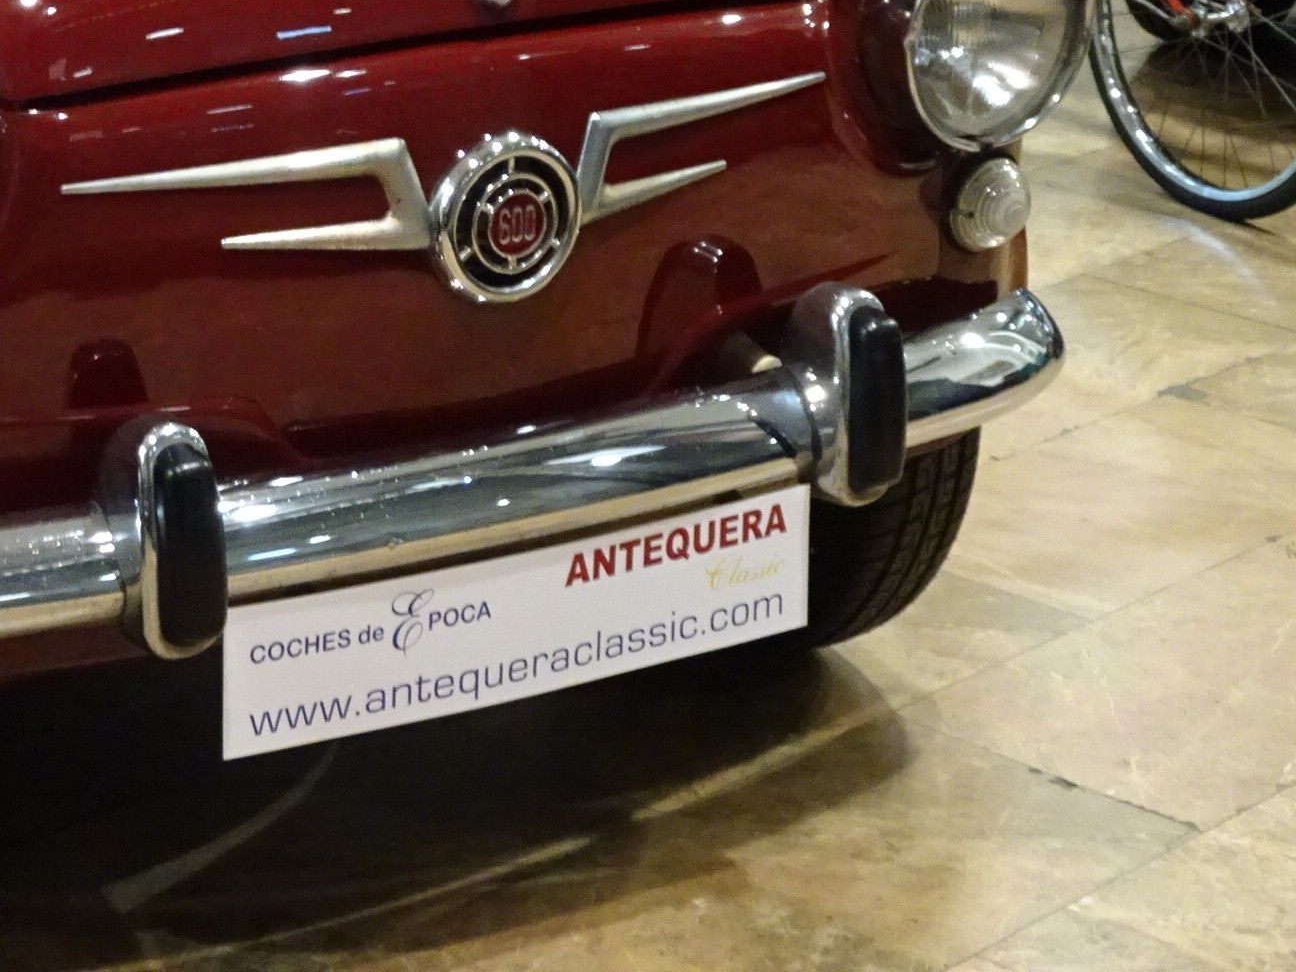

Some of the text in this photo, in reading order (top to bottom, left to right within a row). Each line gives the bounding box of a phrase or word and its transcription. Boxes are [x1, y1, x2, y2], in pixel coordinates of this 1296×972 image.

[499, 203, 537, 246] 600
[565, 504, 787, 587] ANTEQUERA
[250, 629, 351, 664] COCHES
[358, 624, 385, 645] de
[250, 592, 784, 736] www.antequeraclassic.com
